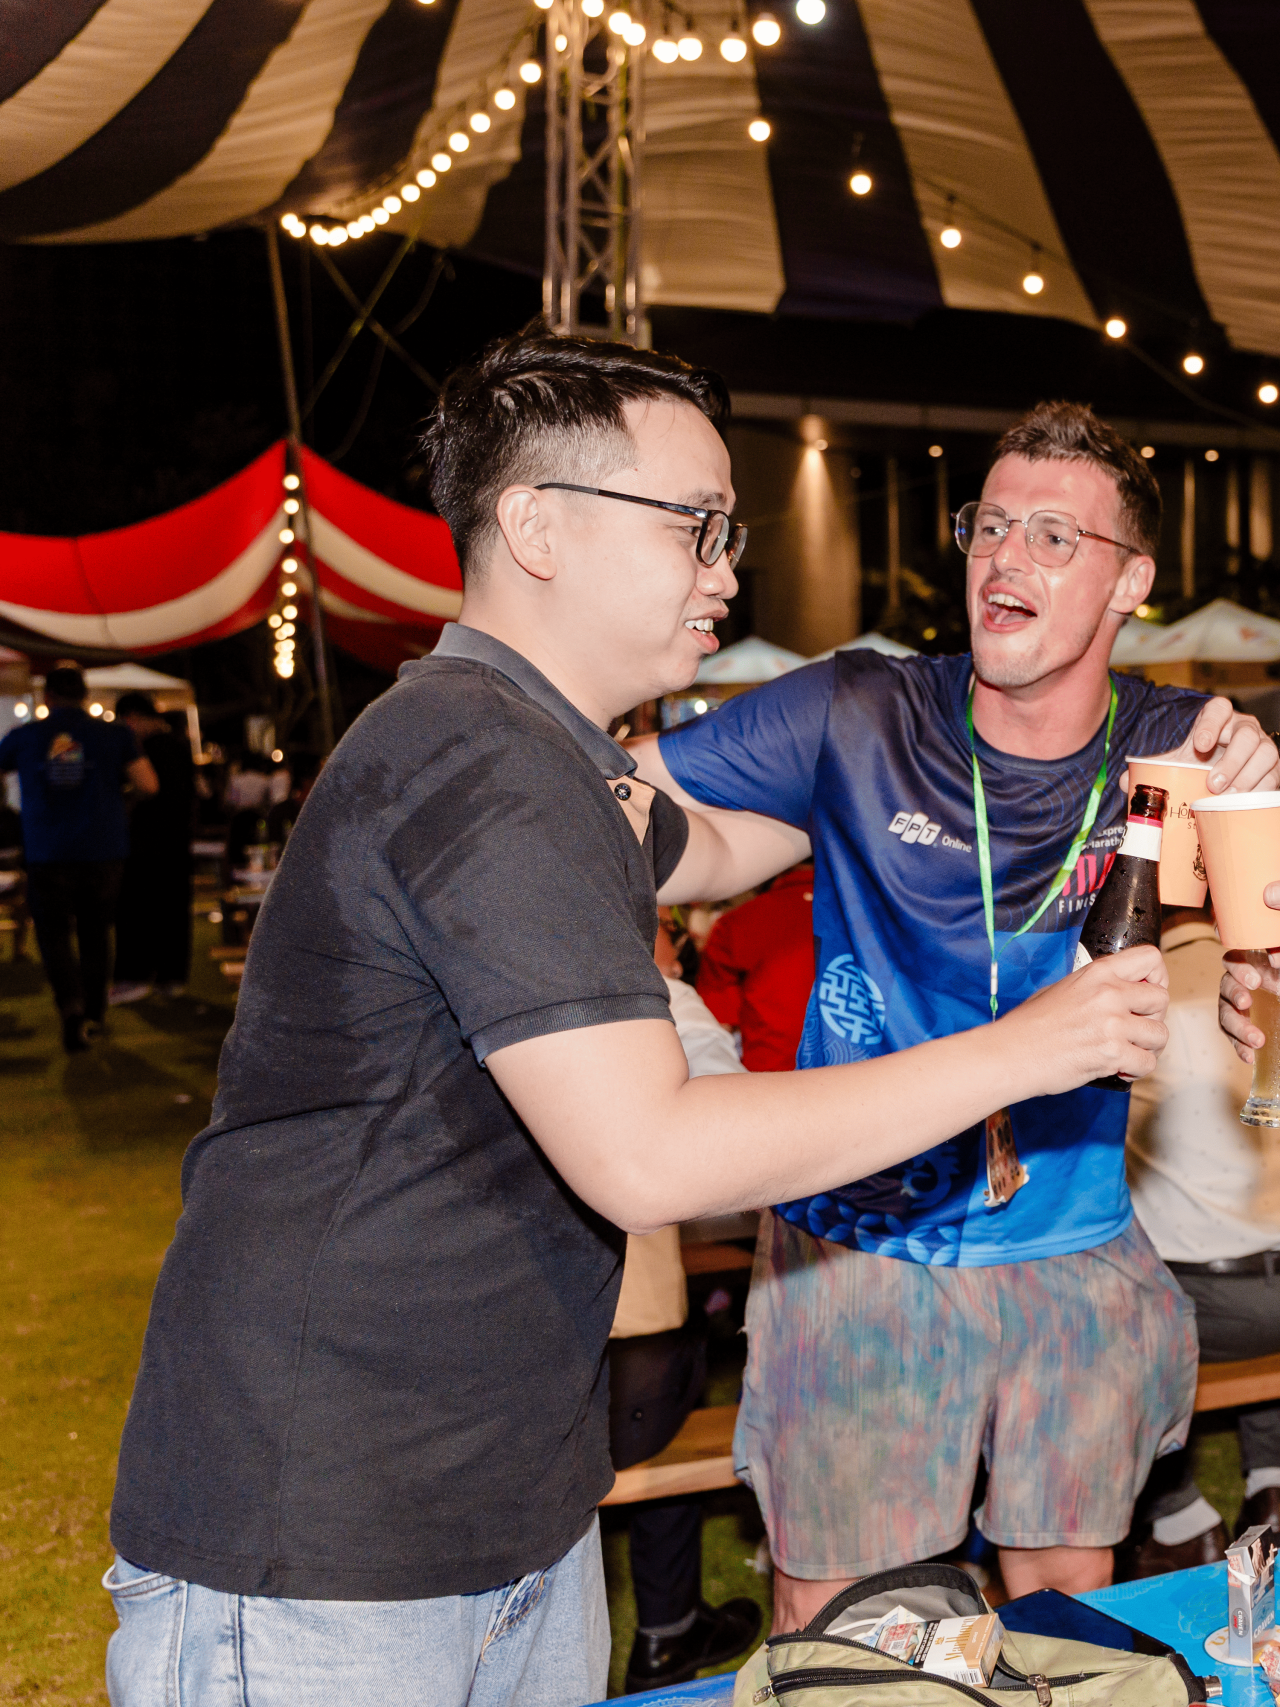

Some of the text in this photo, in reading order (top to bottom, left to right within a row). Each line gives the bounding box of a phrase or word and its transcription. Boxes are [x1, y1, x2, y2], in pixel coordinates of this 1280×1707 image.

[890, 813, 940, 844] FPT
[941, 835, 972, 853] Online
[1058, 892, 1096, 913] FINIS
[1253, 1611, 1275, 1638] CRAVEN
